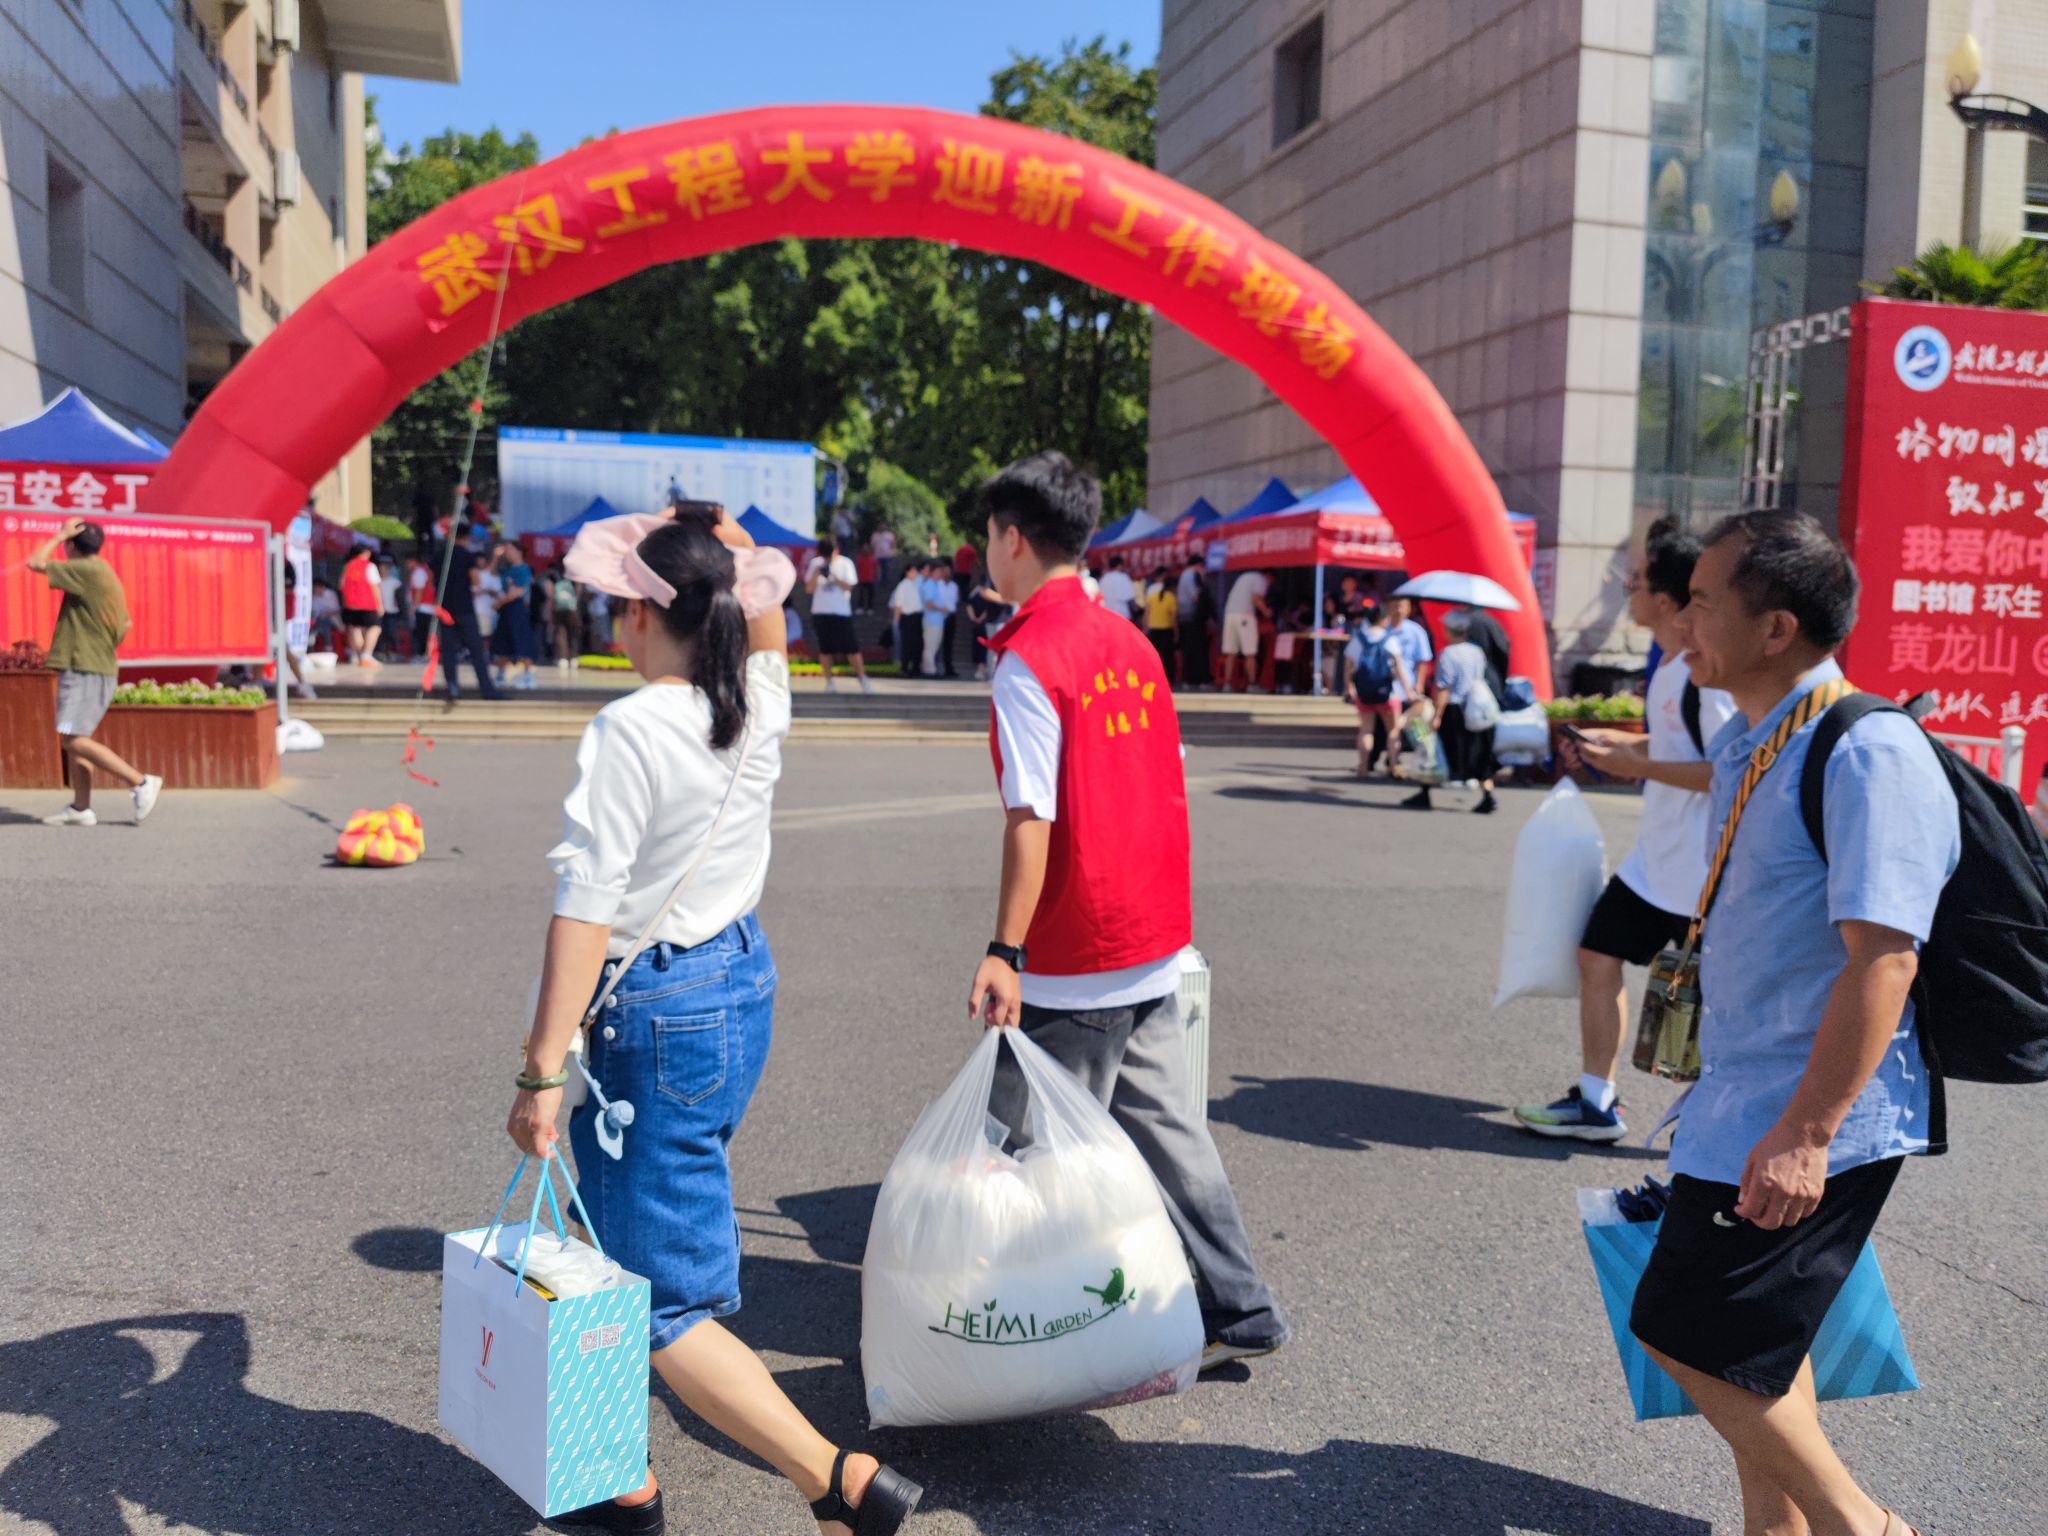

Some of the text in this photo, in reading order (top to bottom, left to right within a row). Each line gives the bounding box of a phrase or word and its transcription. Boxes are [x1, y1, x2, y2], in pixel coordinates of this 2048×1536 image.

[416, 130, 1356, 379] 武汉工程大学迎新工作现场
[1888, 620, 2018, 676] 黄龙山
